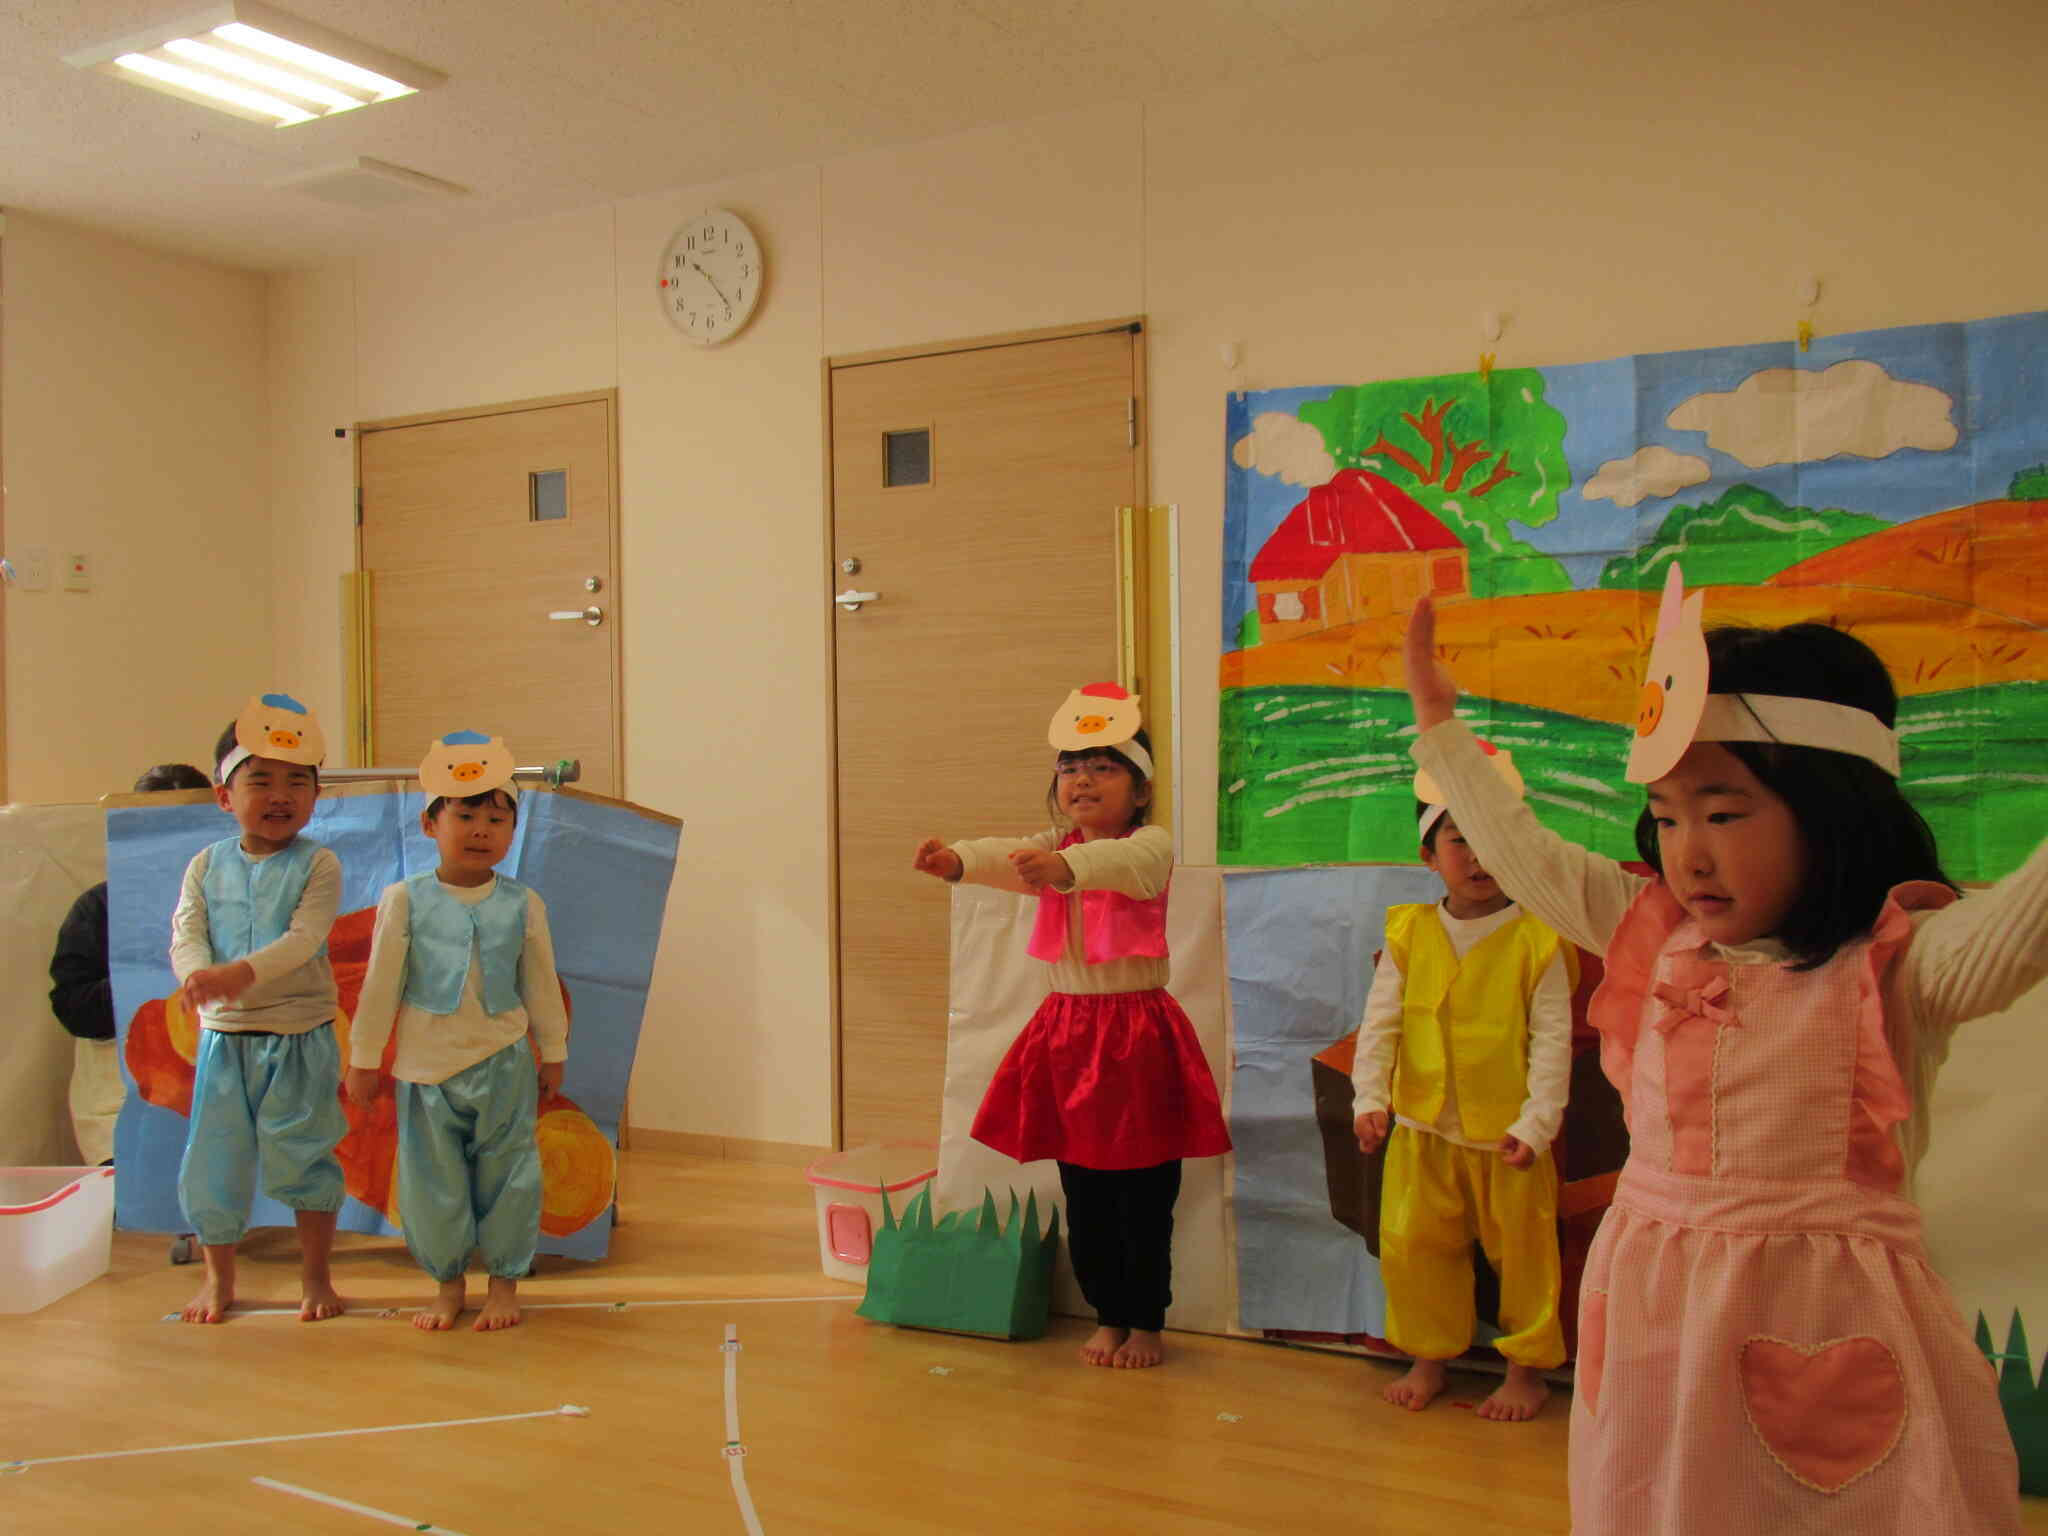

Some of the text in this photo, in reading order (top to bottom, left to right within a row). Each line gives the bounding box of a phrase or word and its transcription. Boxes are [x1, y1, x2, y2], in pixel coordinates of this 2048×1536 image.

[703, 225, 715, 241] 12
[687, 235, 696, 251] 11
[735, 241, 745, 258] 2
[674, 254, 687, 270] 10
[742, 263, 750, 279] 3
[671, 277, 679, 289] 9
[735, 287, 744, 302] 4
[675, 296, 685, 312] 8
[688, 311, 697, 328] 7
[723, 304, 733, 321] 5
[705, 314, 715, 330] 6
